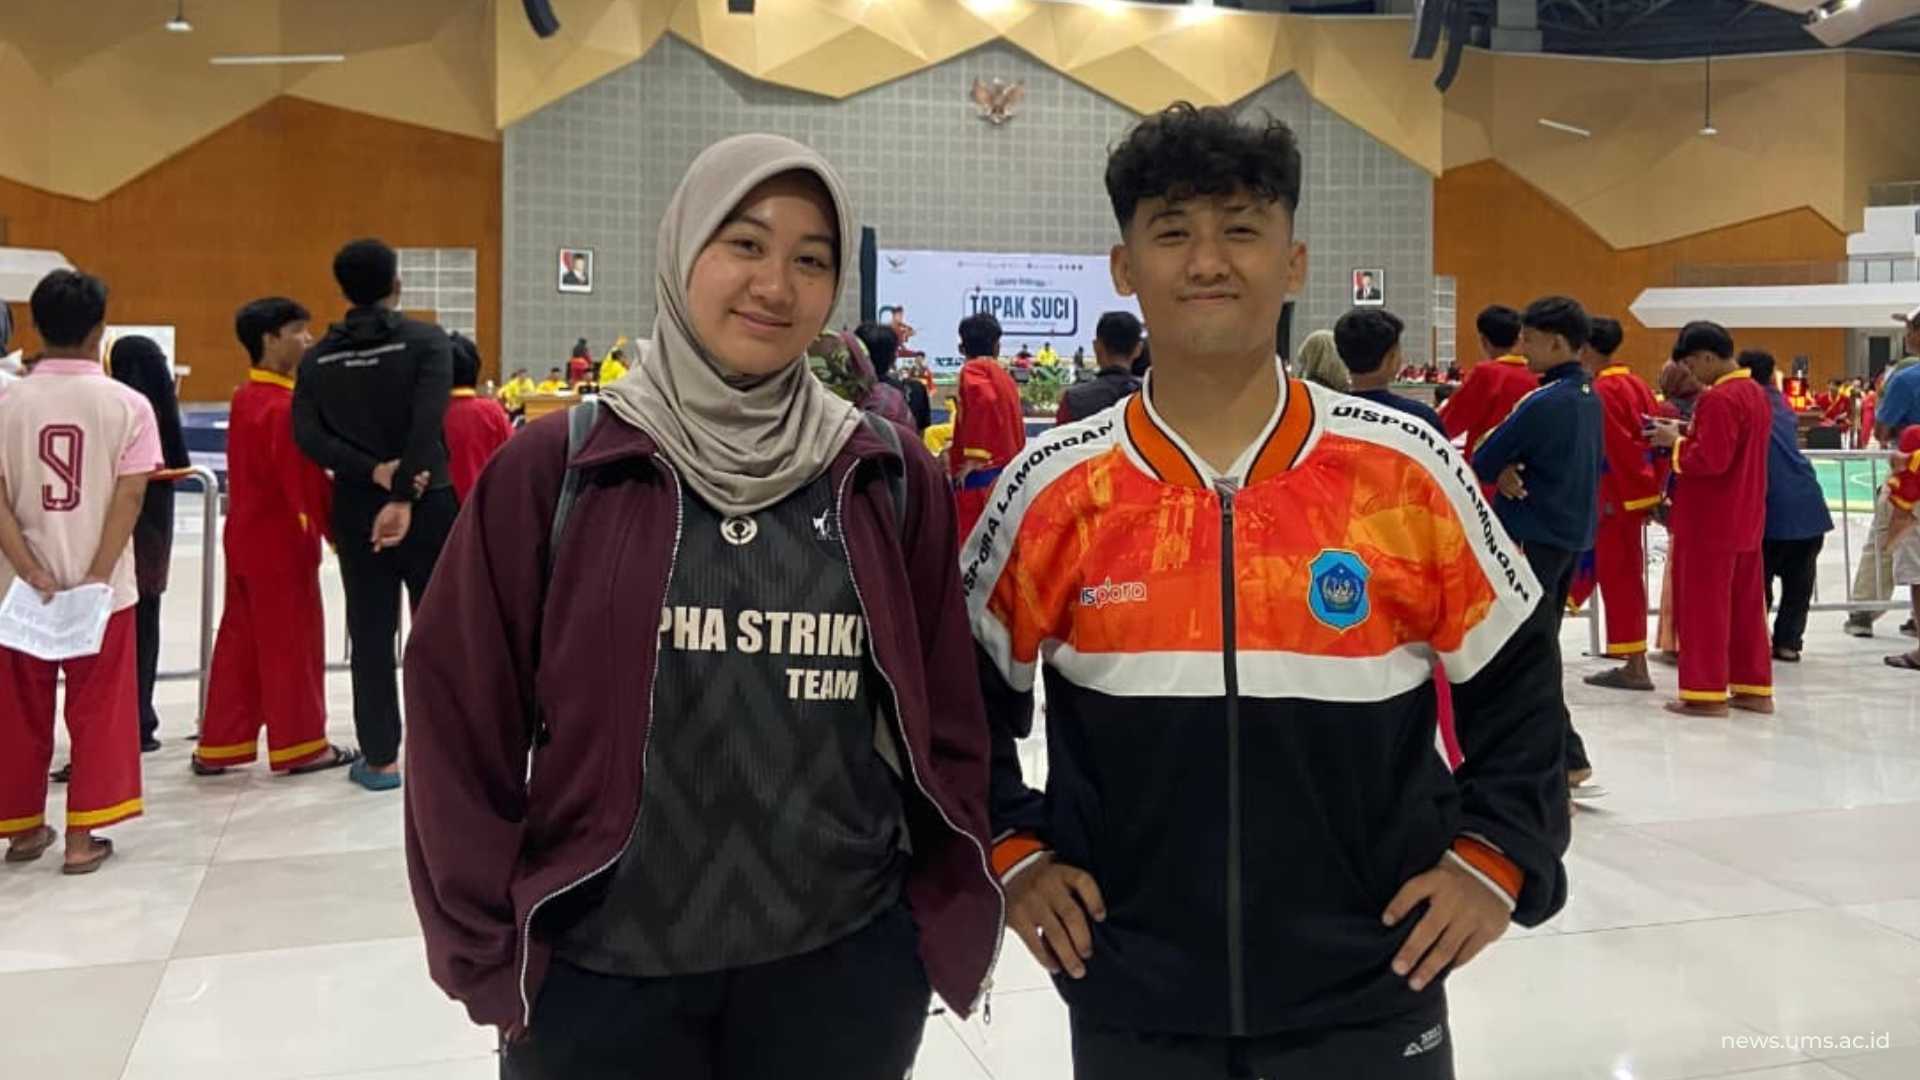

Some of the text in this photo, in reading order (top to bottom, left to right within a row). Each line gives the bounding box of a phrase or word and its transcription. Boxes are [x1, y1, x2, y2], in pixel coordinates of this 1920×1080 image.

[970, 295, 1069, 319] TAPAK SUCI
[39, 424, 84, 511] 9
[996, 420, 1114, 515] LAMONGAN
[1331, 406, 1529, 602] DISPORA LAMONGAN
[786, 668, 859, 700] TEAM
